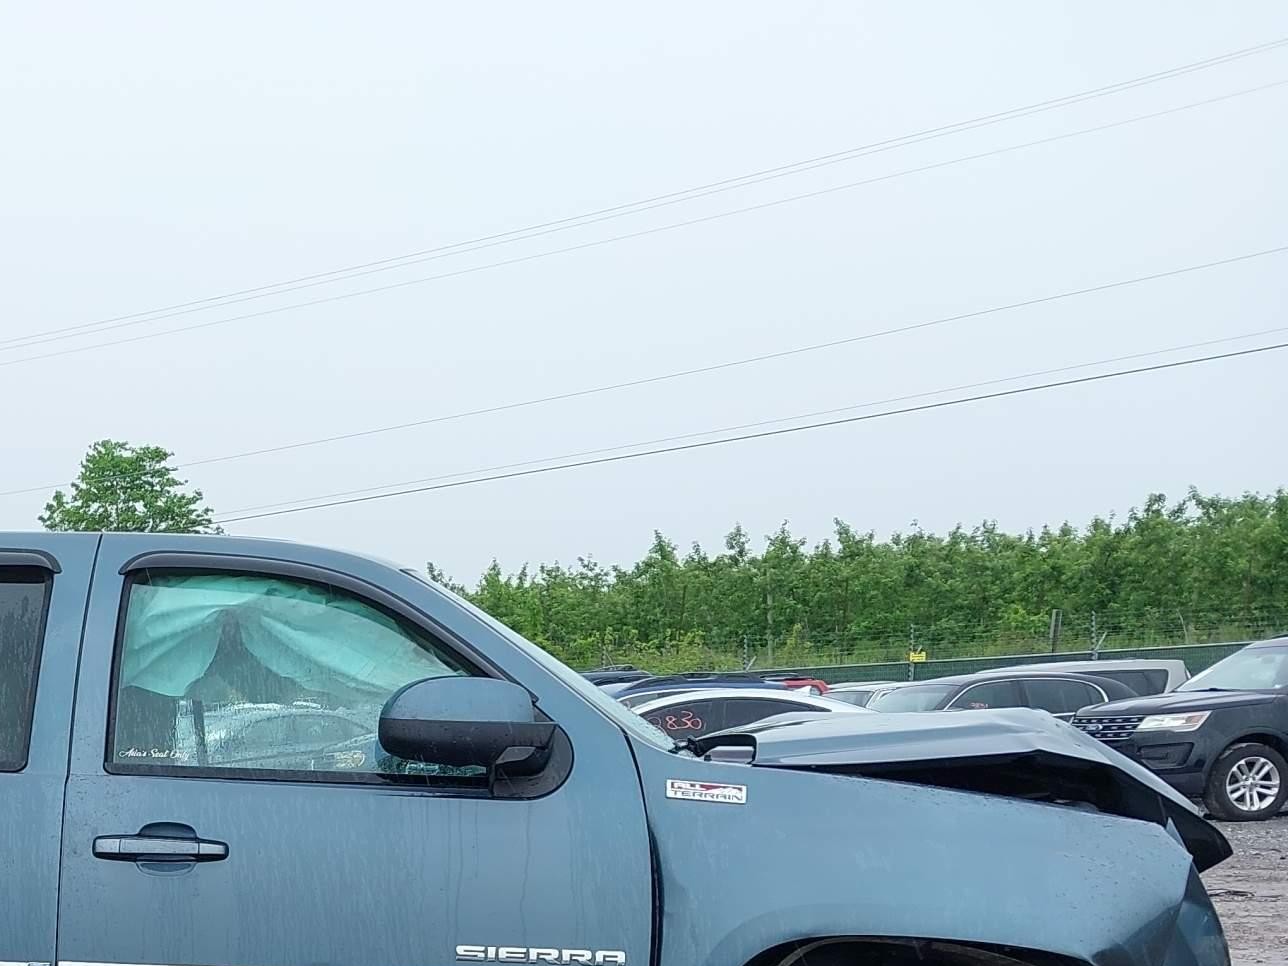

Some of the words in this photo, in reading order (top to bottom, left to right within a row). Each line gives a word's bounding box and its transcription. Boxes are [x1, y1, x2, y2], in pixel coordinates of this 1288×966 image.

[170, 749, 190, 761] Only
[672, 782, 705, 791] ALL
[671, 790, 743, 801] TERRAIN
[455, 945, 627, 966] SIERRA
